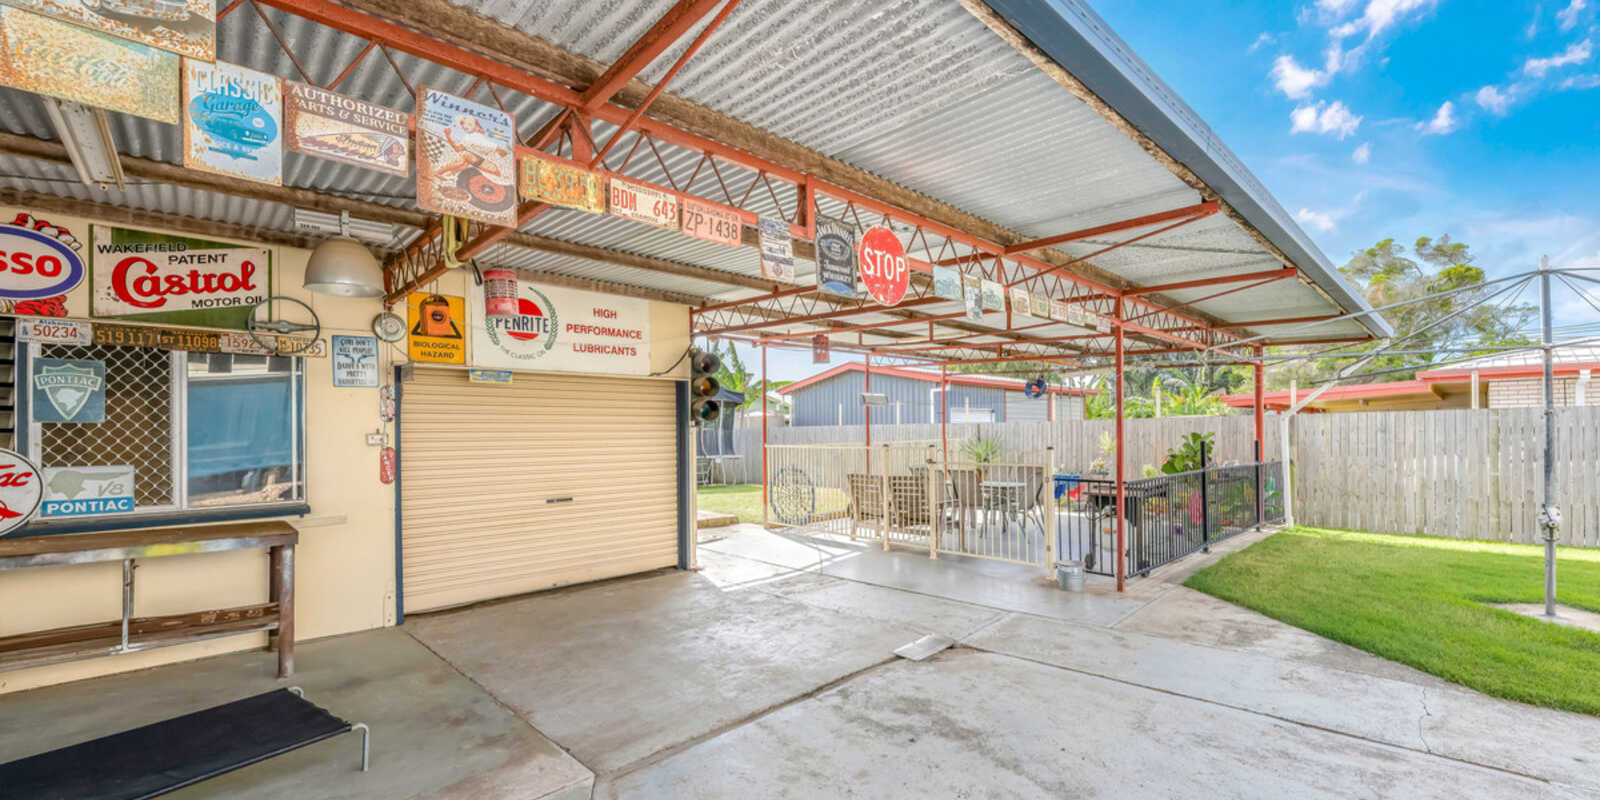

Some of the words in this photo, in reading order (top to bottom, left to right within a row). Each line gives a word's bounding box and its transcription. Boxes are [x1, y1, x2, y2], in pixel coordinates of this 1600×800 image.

[196, 69, 274, 105] CLASSIC
[203, 97, 260, 118] Garage
[291, 85, 407, 124] AUTHORIZED
[338, 109, 350, 120] &
[353, 112, 405, 135] SERVICE
[612, 186, 637, 212] BDM
[653, 200, 676, 221] 643
[97, 242, 187, 254] WAKEFIELD
[168, 253, 228, 265] PATENT
[863, 247, 905, 283] STOP
[111, 256, 256, 308] Castrol
[191, 297, 241, 308] MOTOR
[244, 295, 263, 304] OIL
[593, 308, 617, 319] HIGH
[33, 324, 78, 338] 50234
[495, 316, 550, 333] PENRITE
[566, 323, 642, 339] PERFORMANCE
[413, 341, 460, 350] BIOLOGICAL
[573, 343, 637, 356] LUBRICANTS
[420, 351, 454, 359] HAZARD
[40, 375, 97, 386] PONTIAC
[98, 481, 124, 497] V8
[47, 499, 128, 514] PONTIAC
